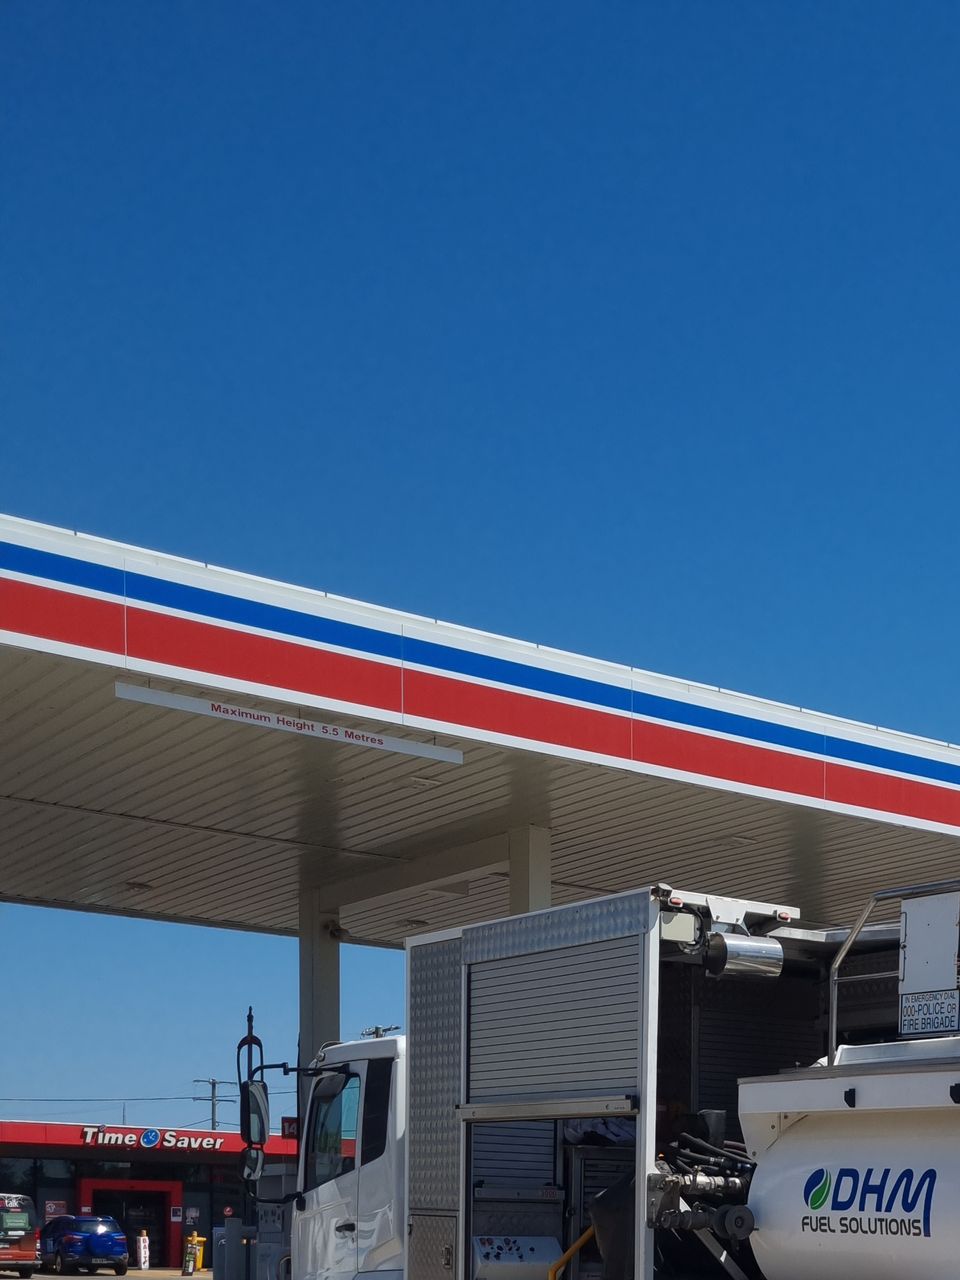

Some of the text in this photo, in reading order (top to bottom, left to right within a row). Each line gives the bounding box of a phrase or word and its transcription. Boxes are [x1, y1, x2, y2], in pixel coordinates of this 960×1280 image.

[210, 703, 384, 745] Maximum Height 5.5 Metres
[911, 993, 943, 1003] EMERGENCY
[944, 992, 956, 1000] DIAL
[903, 1002, 957, 1017] 000-POLICE OR
[903, 1015, 956, 1031] FIRE BRIGADE
[83, 1126, 225, 1149] Time Saver
[831, 1168, 937, 1237] DHM
[802, 1216, 921, 1236] FUEL SOLUTIONS
